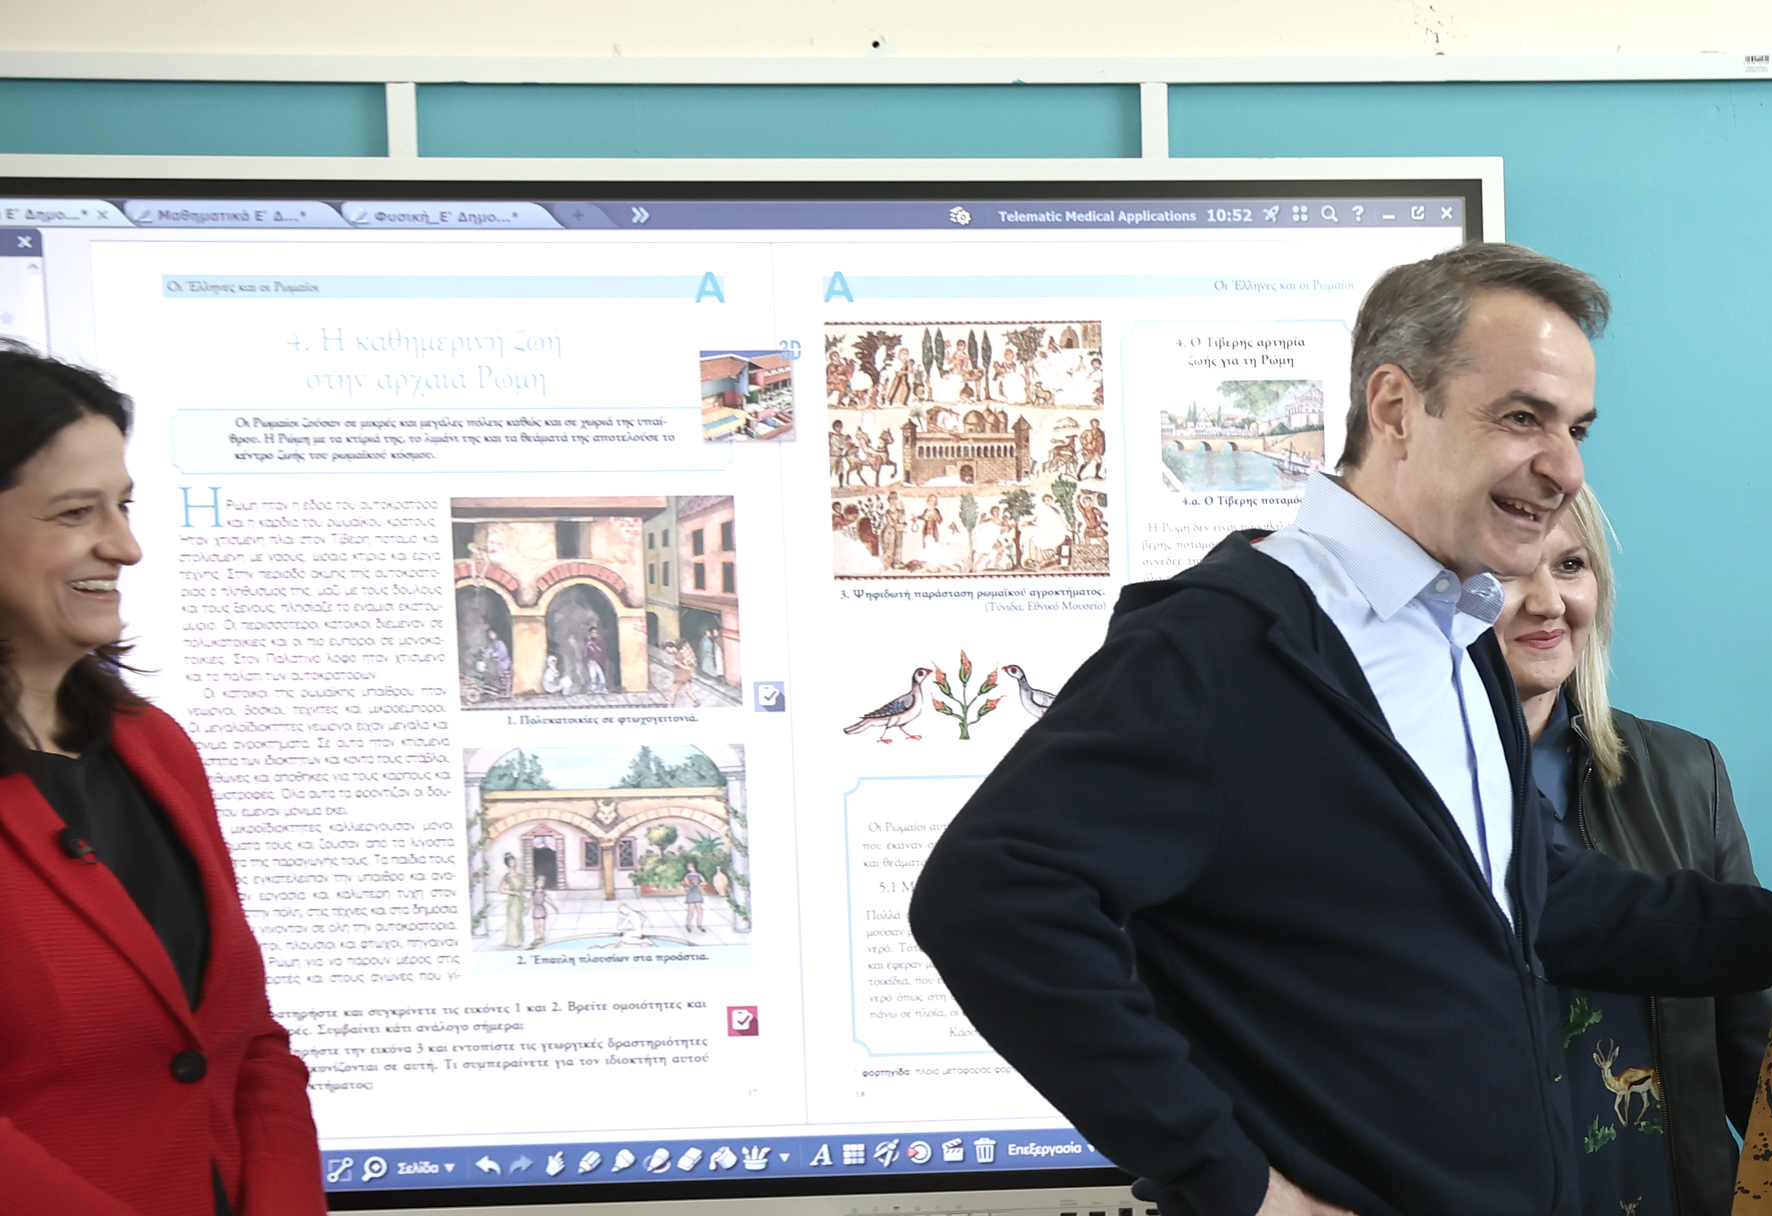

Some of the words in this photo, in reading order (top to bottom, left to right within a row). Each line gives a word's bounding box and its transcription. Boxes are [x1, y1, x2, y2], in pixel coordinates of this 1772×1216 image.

[158, 208, 250, 222] Μαθηματικά
[999, 210, 1062, 223] Telematic
[1065, 210, 1115, 223] Medical
[1118, 210, 1197, 226] Applications
[1207, 210, 1252, 223] 10:52
[1214, 279, 1228, 292] Οι
[1232, 278, 1278, 294] Έλληνες
[1281, 281, 1298, 292] και
[321, 328, 345, 351] Η
[357, 328, 504, 358] καθημερινή
[514, 328, 561, 358] ζωή
[1207, 337, 1252, 350] Τίβερης
[1257, 337, 1305, 350] αρτηρία
[1188, 356, 1217, 368] ζωής
[1221, 357, 1239, 368] για
[1243, 358, 1256, 368] τη
[1261, 354, 1294, 368] Ρώμη
[306, 372, 364, 396] στην
[377, 366, 466, 397] αρχαία
[477, 366, 547, 395] Ρώμη
[1204, 496, 1214, 506] Ο
[1218, 495, 1257, 508] Τίβερης
[1148, 522, 1158, 533] Η
[853, 588, 911, 601] Ψηφιδωτή
[914, 588, 973, 601] παράσταση
[976, 587, 1026, 600] ρωμαϊκού
[1029, 587, 1106, 600] αγροκτήματος.
[879, 882, 897, 893] 5.1
[633, 954, 653, 963] στα
[344, 1007, 363, 1018] και
[443, 1005, 460, 1016] τις
[527, 1004, 546, 1014] και
[551, 1002, 564, 1014] 2.
[568, 1001, 608, 1015] Βρείτε
[613, 999, 683, 1013] ομοιότητες
[687, 998, 707, 1010] και
[385, 1021, 412, 1034] κάτι
[473, 1018, 524, 1034] σήμερα;
[416, 1042, 424, 1055] 3
[428, 1043, 448, 1055] και
[452, 1040, 515, 1055] εντοπίστε
[520, 1040, 538, 1053] τις
[541, 1038, 605, 1054] γεωργικές
[608, 1035, 708, 1051] δραστηριότητες
[384, 1063, 400, 1073] σε
[443, 1057, 458, 1070] Τι
[463, 1056, 550, 1071] συμπεραίνετε
[554, 1056, 574, 1069] για
[580, 1056, 599, 1067] τον
[604, 1053, 667, 1067] ιδιοκτήτη
[1008, 1141, 1082, 1158] Επεξεργασία
[397, 1160, 440, 1175] Σελίδα
